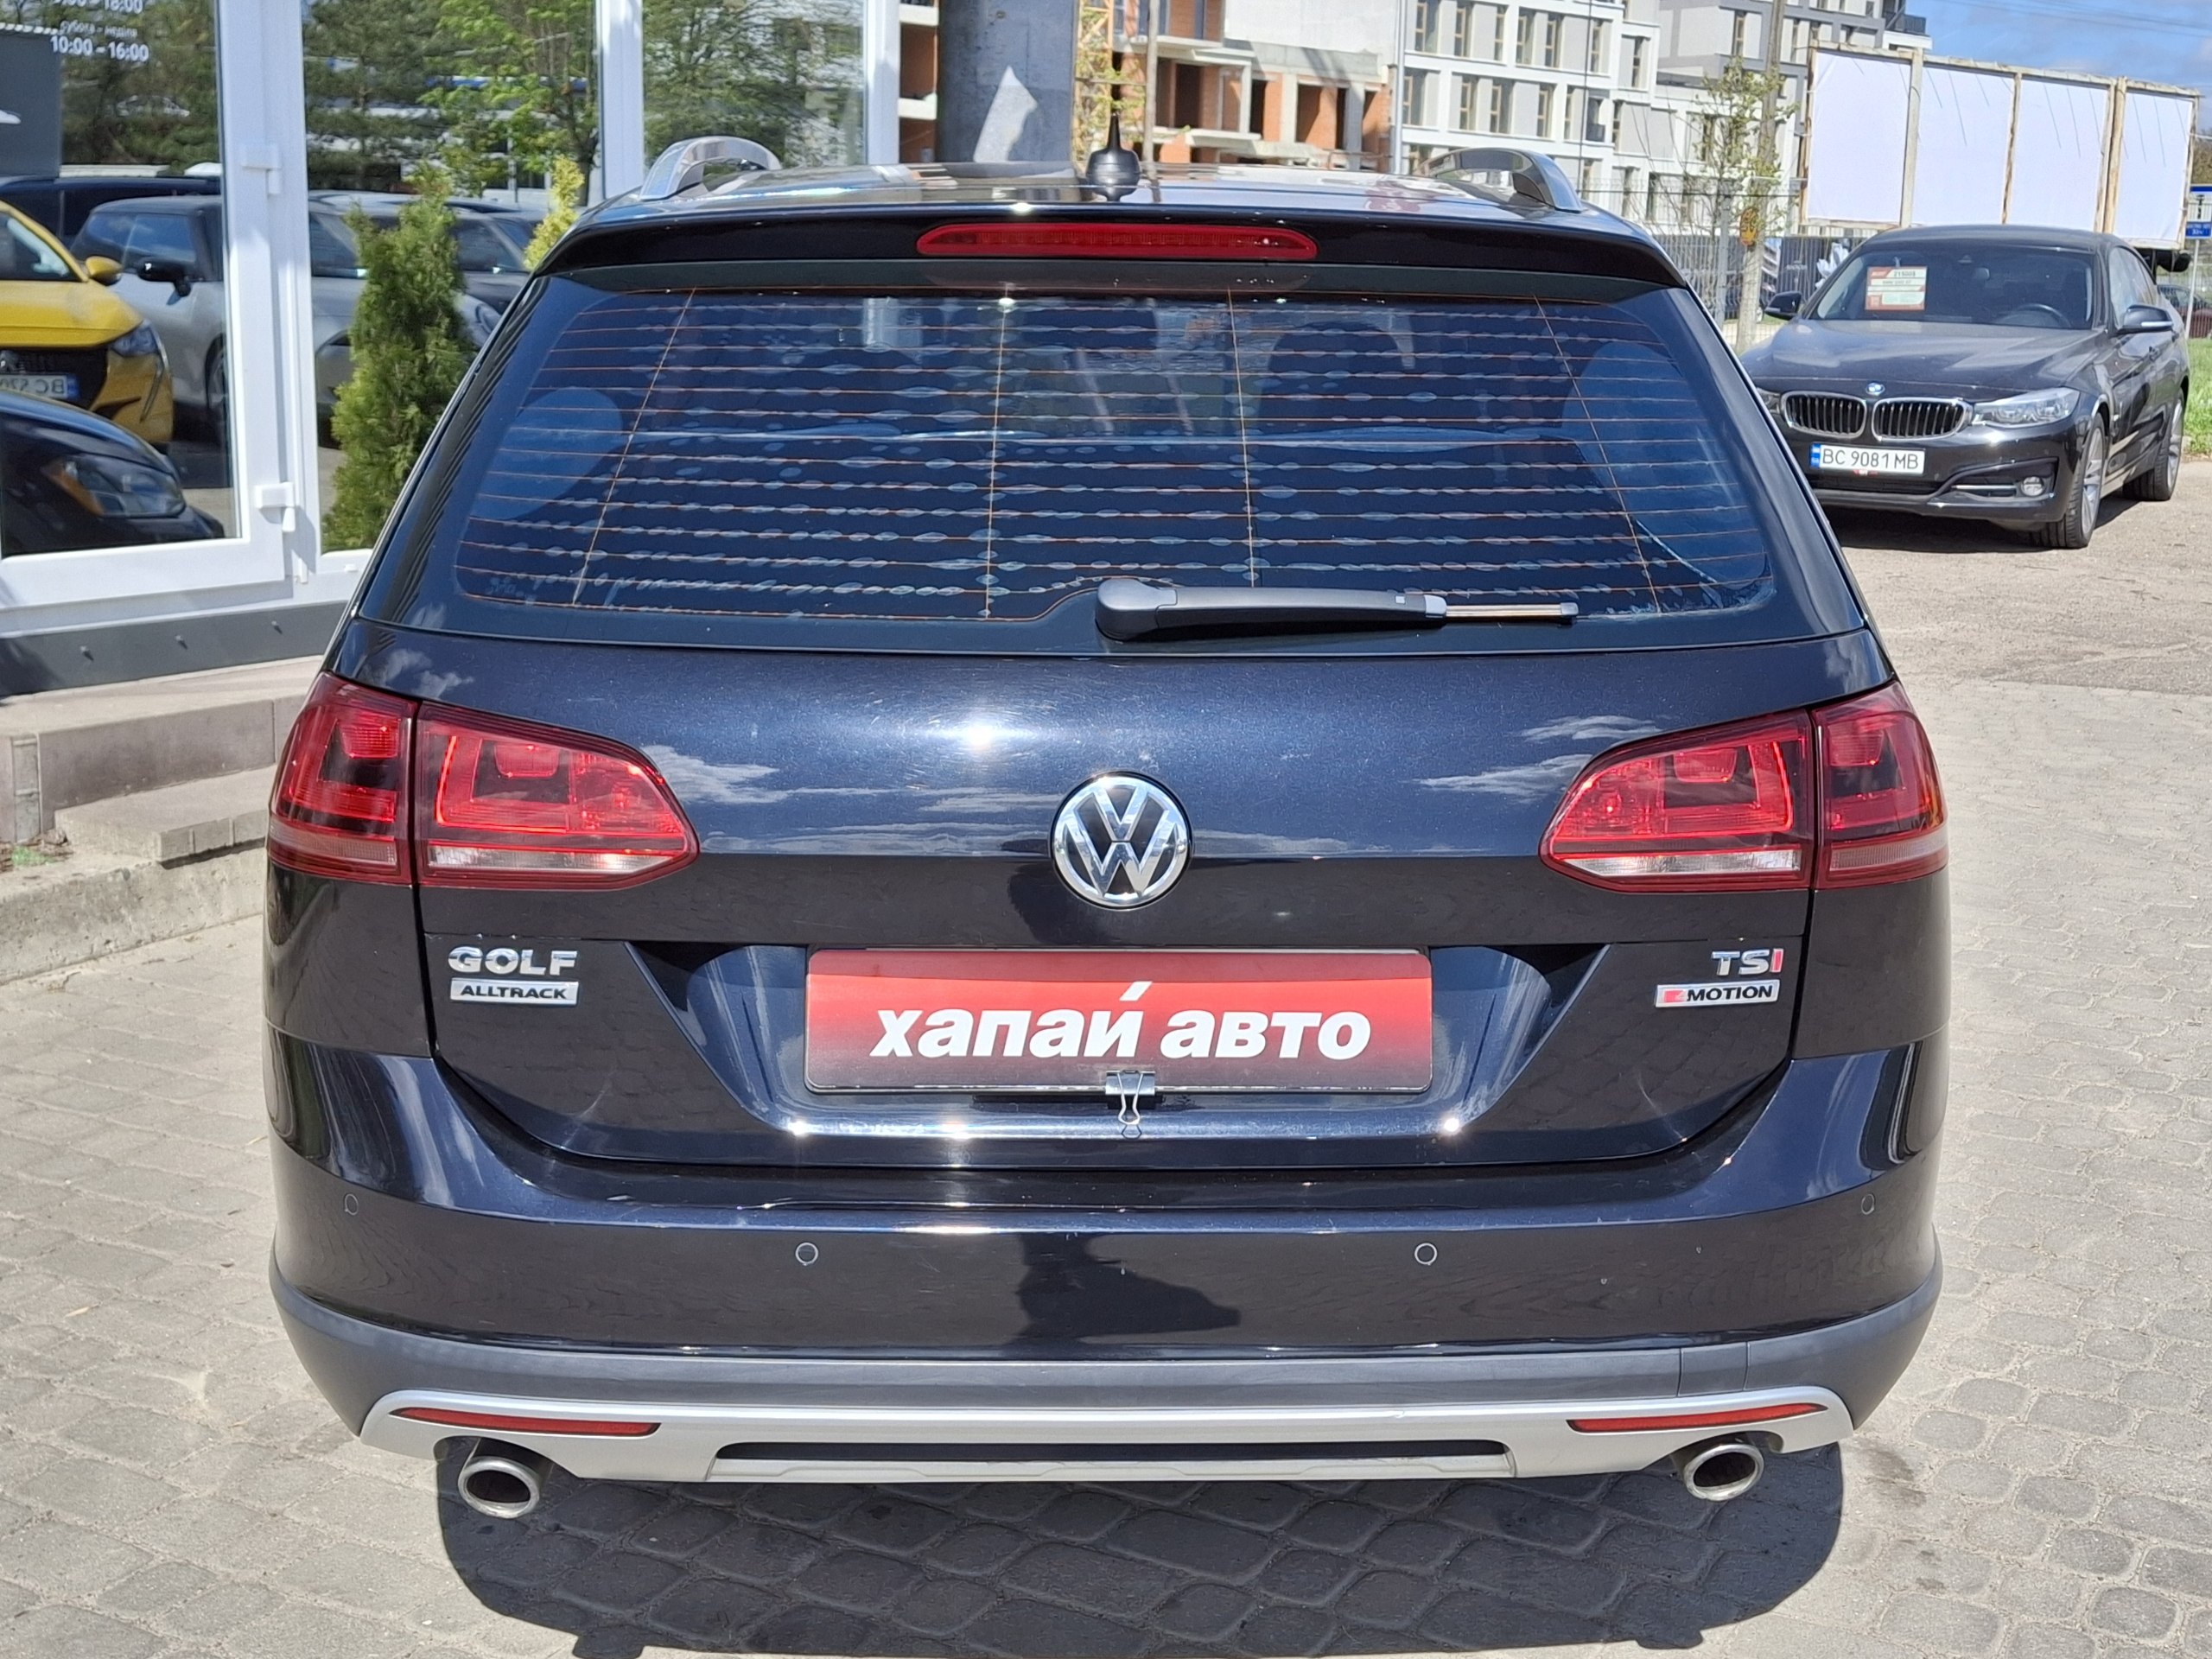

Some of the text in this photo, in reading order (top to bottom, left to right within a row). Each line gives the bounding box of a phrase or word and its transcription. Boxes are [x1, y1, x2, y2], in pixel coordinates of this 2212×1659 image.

[50, 35, 93, 56] 10:00
[108, 41, 149, 61] 16:00
[1822, 448, 1918, 469] BC 9081 MB
[448, 946, 578, 976] GOLF
[1712, 948, 1784, 976] TSI
[461, 985, 567, 1000] ALLTRACK
[869, 981, 1371, 1060] хапай авто
